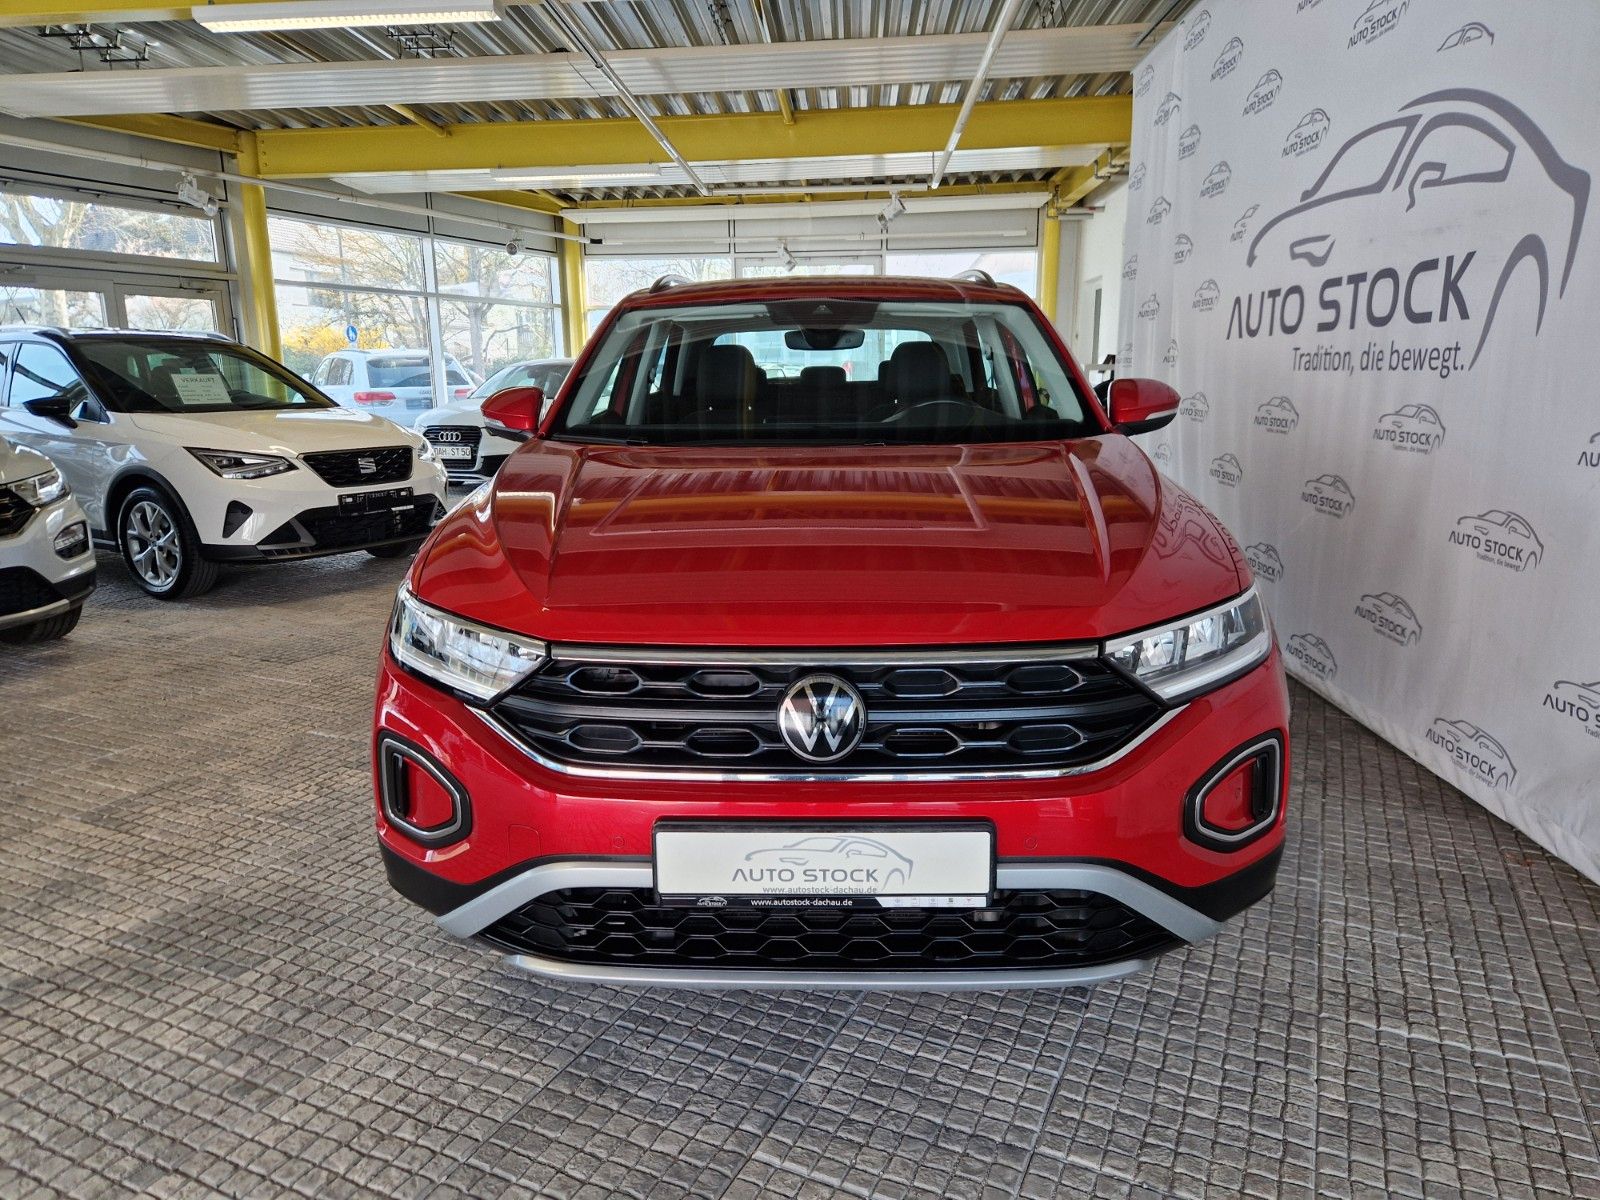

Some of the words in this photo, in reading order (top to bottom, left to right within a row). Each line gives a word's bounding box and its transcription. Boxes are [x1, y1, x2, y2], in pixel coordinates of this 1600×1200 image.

[1347, 27, 1369, 50] AUTO
[1370, 8, 1398, 35] STOCK
[1242, 102, 1257, 117] AUTO
[1257, 89, 1274, 108] STOCK
[1282, 141, 1299, 158] AUTO
[1299, 130, 1320, 150] STOCK
[1226, 285, 1305, 340] AUTO
[1316, 250, 1477, 332] STOCK
[1292, 345, 1355, 377] Tradition,
[1360, 341, 1383, 371] die
[1388, 340, 1465, 379] bewegt.
[1254, 416, 1269, 426] AUTO
[1270, 417, 1288, 428] STOCK
[1373, 429, 1397, 441] AUTO
[1398, 431, 1431, 446] STOCK
[1301, 492, 1318, 504] AUTO
[1319, 496, 1344, 511] STOCK
[1448, 531, 1481, 549] AUTO
[1484, 539, 1524, 562] STOCK
[1257, 561, 1276, 577] STOCK
[1354, 605, 1377, 623] AUTO
[1378, 616, 1408, 639] STOCK
[1285, 643, 1304, 660] AUTO
[1304, 654, 1326, 674] STOCK
[1543, 694, 1589, 722] AUTO
[1425, 728, 1454, 753] AUTO
[1455, 746, 1497, 779] STOCK
[732, 868, 795, 882] AUTO
[803, 868, 879, 882] STOCK
[762, 886, 877, 894] www.autostock-dachau.de
